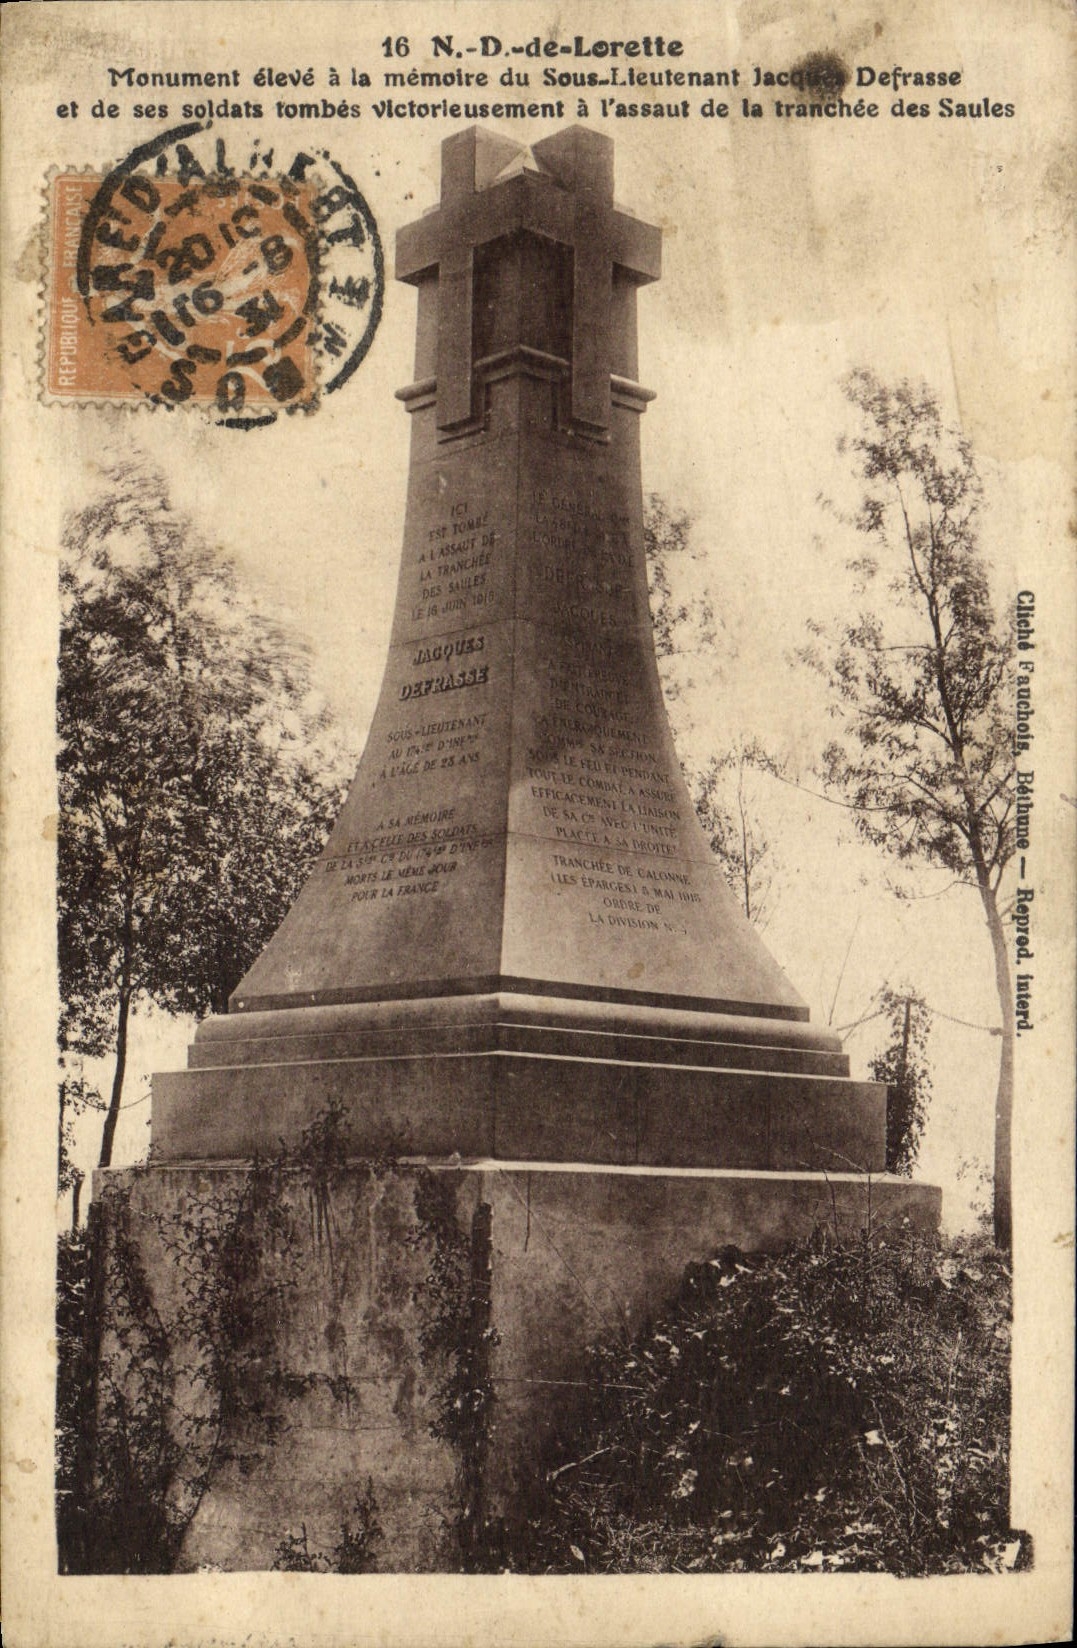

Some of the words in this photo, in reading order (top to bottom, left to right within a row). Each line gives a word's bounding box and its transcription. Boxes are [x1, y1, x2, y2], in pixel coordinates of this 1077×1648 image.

[58, 296, 81, 387] REPUBLIQUE
[451, 503, 468, 517] ICI
[429, 526, 448, 541] EST
[452, 511, 489, 536] TOMBÉ
[482, 530, 496, 547] DE
[420, 569, 432, 582] LA
[438, 549, 493, 578] TRANCHÉE
[422, 584, 443, 600] DES
[448, 572, 488, 594] SAULES
[411, 607, 424, 622] LE
[441, 598, 468, 614] JUIN
[412, 636, 486, 666] JACQUES
[398, 664, 490, 701] DEFRASSE
[386, 713, 488, 744] SOUS-LIEUTENANT
[389, 748, 403, 761] AU
[423, 758, 437, 773] DE
[458, 751, 481, 766] ANS
[589, 742, 606, 756] SA
[608, 746, 658, 764] SECTION
[526, 766, 559, 785] TOUT
[561, 772, 575, 786] LE
[563, 754, 578, 768] LE
[580, 758, 602, 772] FEU
[603, 763, 618, 776] ET
[620, 765, 670, 786] PENDANT
[530, 785, 618, 811] EFFICACEMENT
[621, 803, 637, 815] LA
[638, 804, 681, 822] LIAISON
[387, 817, 401, 829] SA
[404, 807, 457, 827] MÉMOIRE
[542, 804, 558, 819] DE
[562, 809, 579, 823] SA
[600, 816, 630, 830] AVEC
[632, 821, 678, 840] L'UNITÉ
[368, 832, 404, 851] CELLE
[406, 832, 428, 845] DES
[430, 823, 479, 842] SOLDATS
[603, 835, 612, 846] A
[615, 838, 630, 850] SA
[325, 861, 337, 873] DE
[340, 859, 353, 872] LA
[398, 850, 414, 863] DU
[551, 854, 615, 875] TRANCHÉE
[616, 864, 634, 877] DE
[343, 871, 378, 888] MORTS
[381, 869, 394, 882] LE
[397, 863, 426, 879] MÊME
[427, 860, 459, 877] JOUR
[350, 888, 379, 903] POUR
[381, 886, 394, 899] LA
[397, 880, 441, 897] FRANCE
[653, 887, 675, 900] MAI
[602, 896, 645, 913] ORDRE
[645, 903, 662, 916] DE
[588, 911, 605, 926] LA
[607, 914, 660, 931] DIVISION
